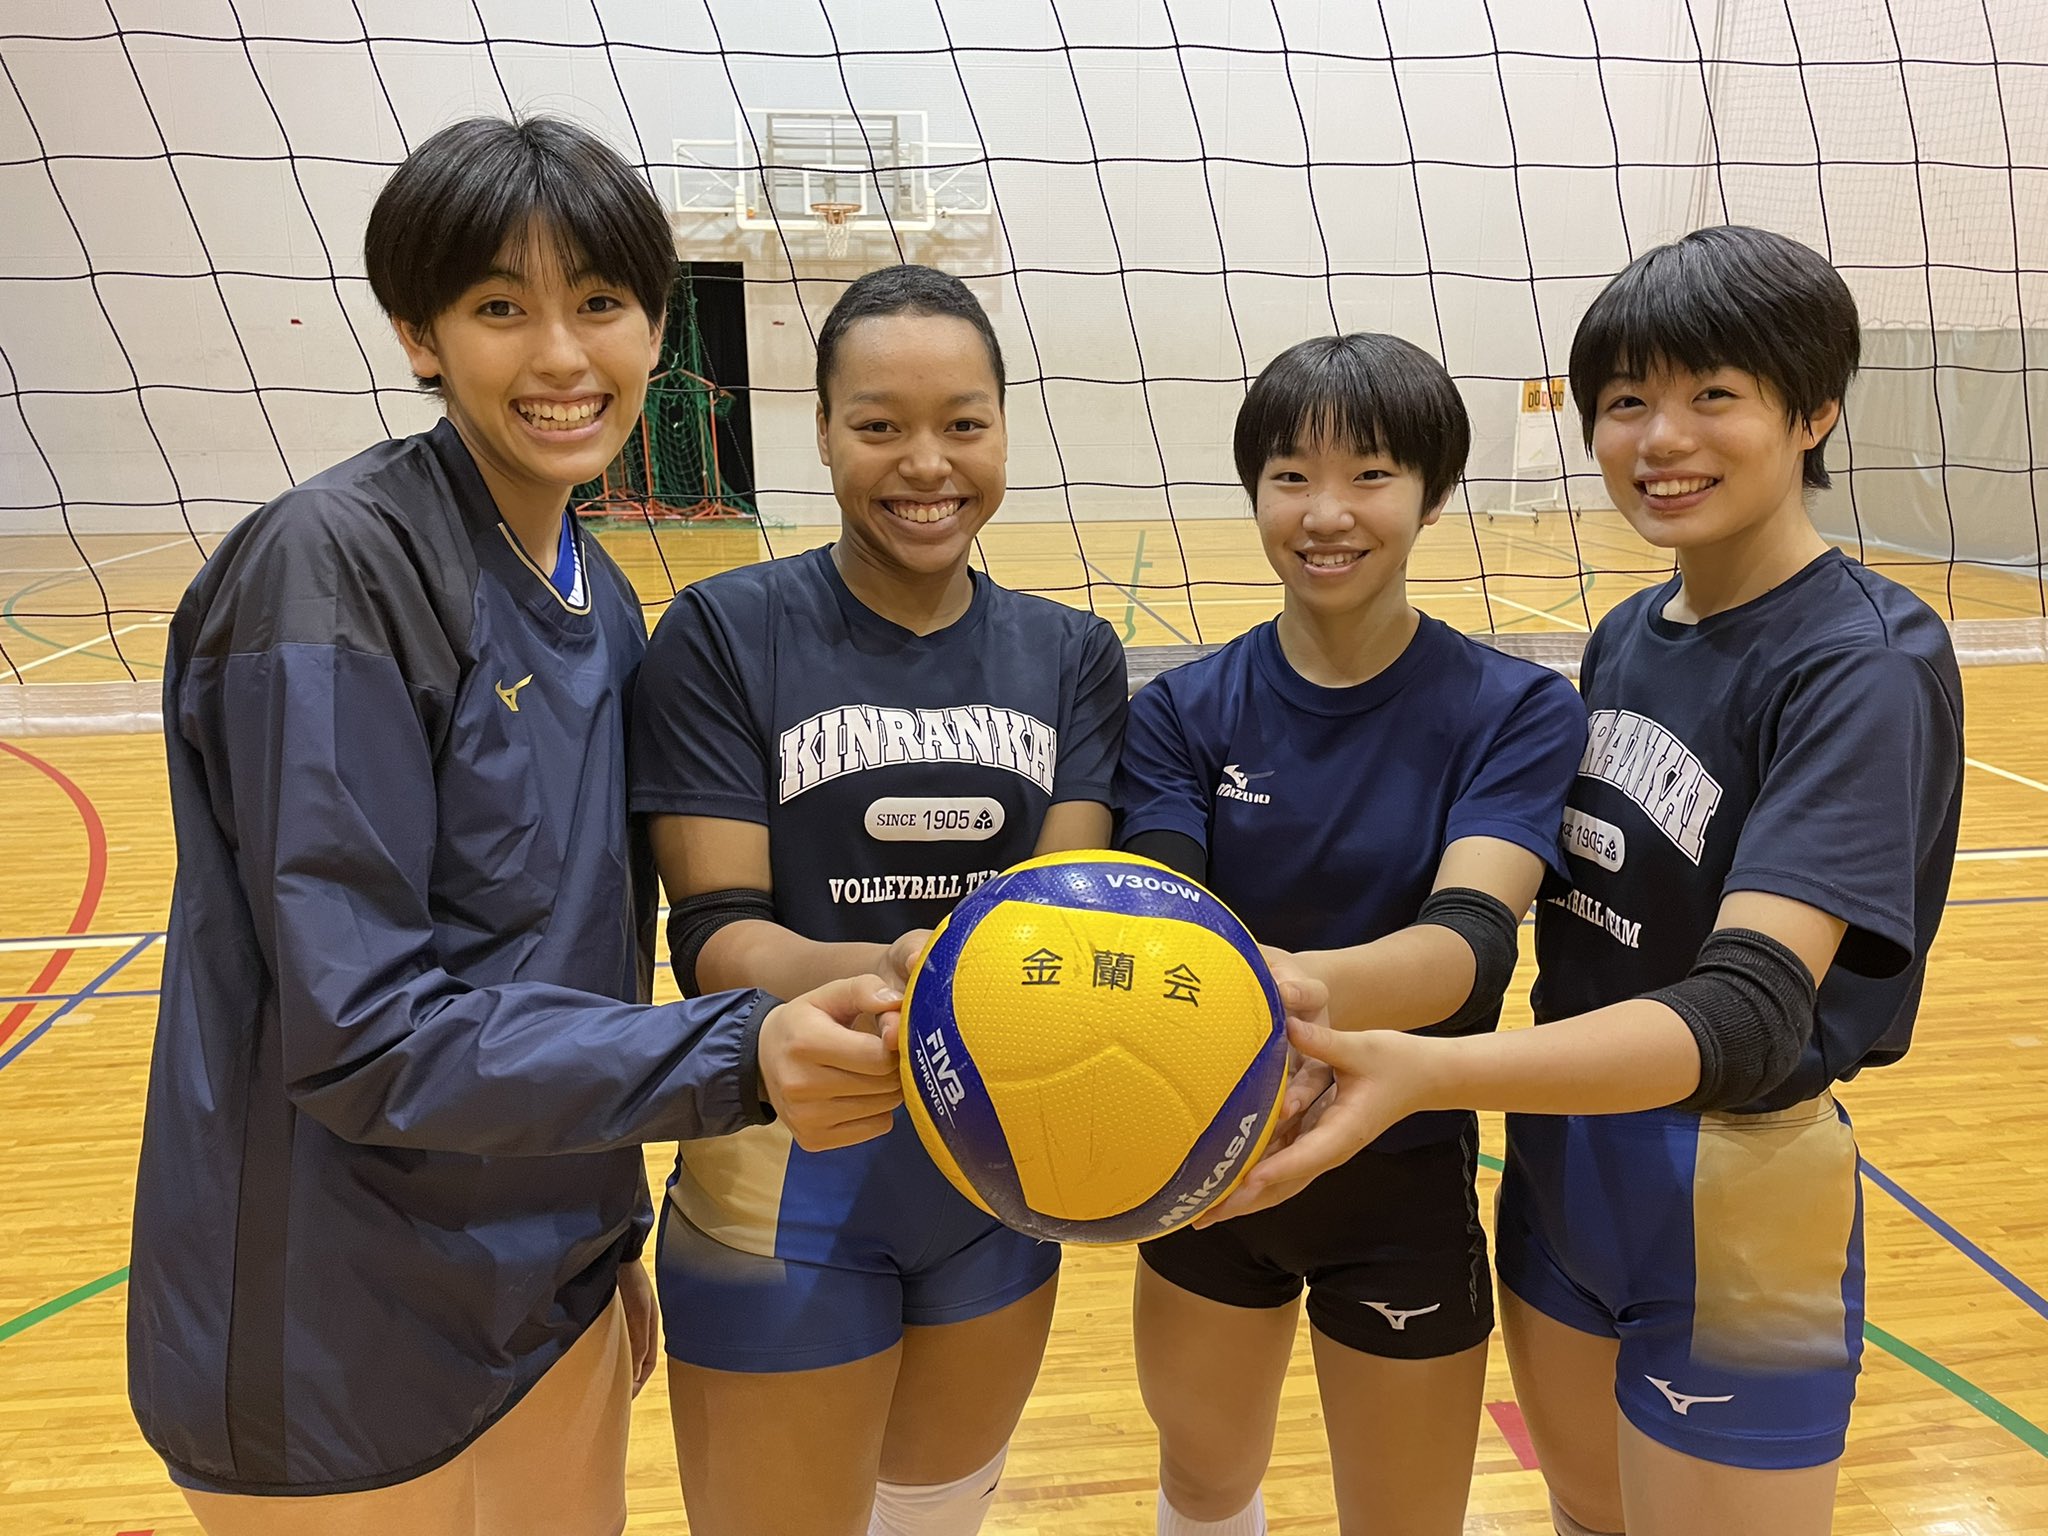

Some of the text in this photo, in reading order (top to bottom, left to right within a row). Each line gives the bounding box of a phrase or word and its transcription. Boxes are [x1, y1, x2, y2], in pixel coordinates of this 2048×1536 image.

[780, 704, 1057, 804] KINRANKA
[876, 809, 970, 831] SINCE 1905
[1576, 825, 1605, 855] 1905
[829, 874, 962, 904] VOLLEYBALL
[1105, 873, 1201, 903] V300W
[1605, 906, 1642, 949] TEAM
[1021, 947, 1202, 1008] 金蘭会
[915, 1049, 945, 1117] APPROVED
[926, 1027, 966, 1106] FIVB
